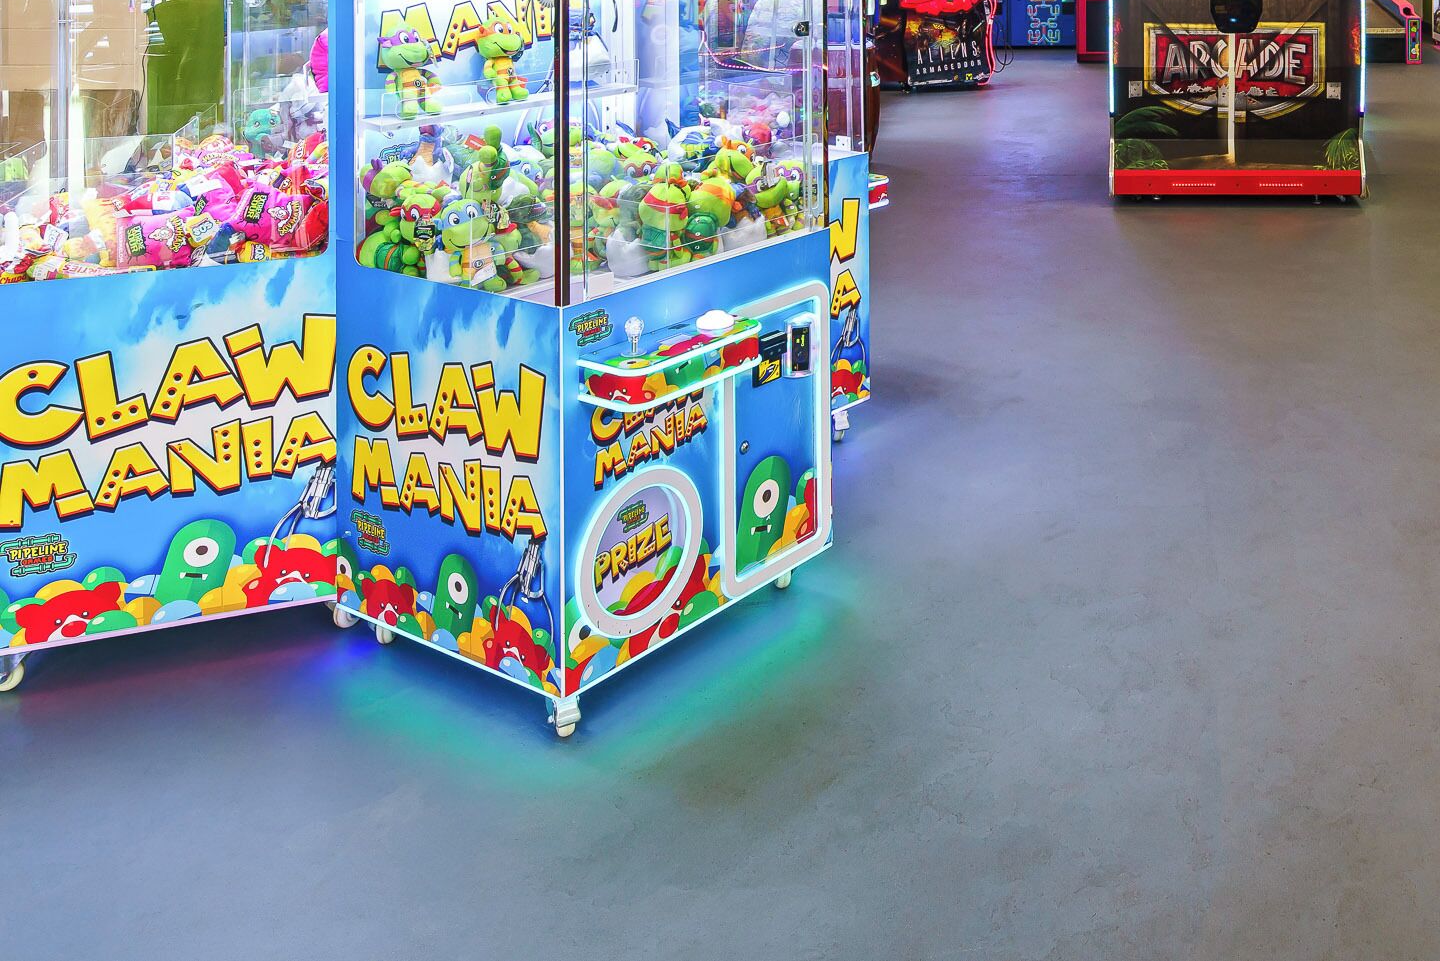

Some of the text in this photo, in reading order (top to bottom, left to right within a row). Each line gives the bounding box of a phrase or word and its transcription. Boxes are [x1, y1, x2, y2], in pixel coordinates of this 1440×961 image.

[916, 59, 982, 75] ARMAGEDDON
[917, 40, 978, 65] ALIENS
[1162, 38, 1307, 85] ARCADE
[577, 316, 607, 333] PIPELINE
[0, 313, 336, 446] CLAW
[347, 344, 546, 464] CLAW
[0, 411, 336, 530] MANIA
[593, 402, 709, 491] MANIA
[352, 435, 548, 543] MANIA
[10, 542, 67, 560] PIPELINE
[357, 520, 385, 539] PIPELINE
[594, 513, 672, 593] PRIZE
